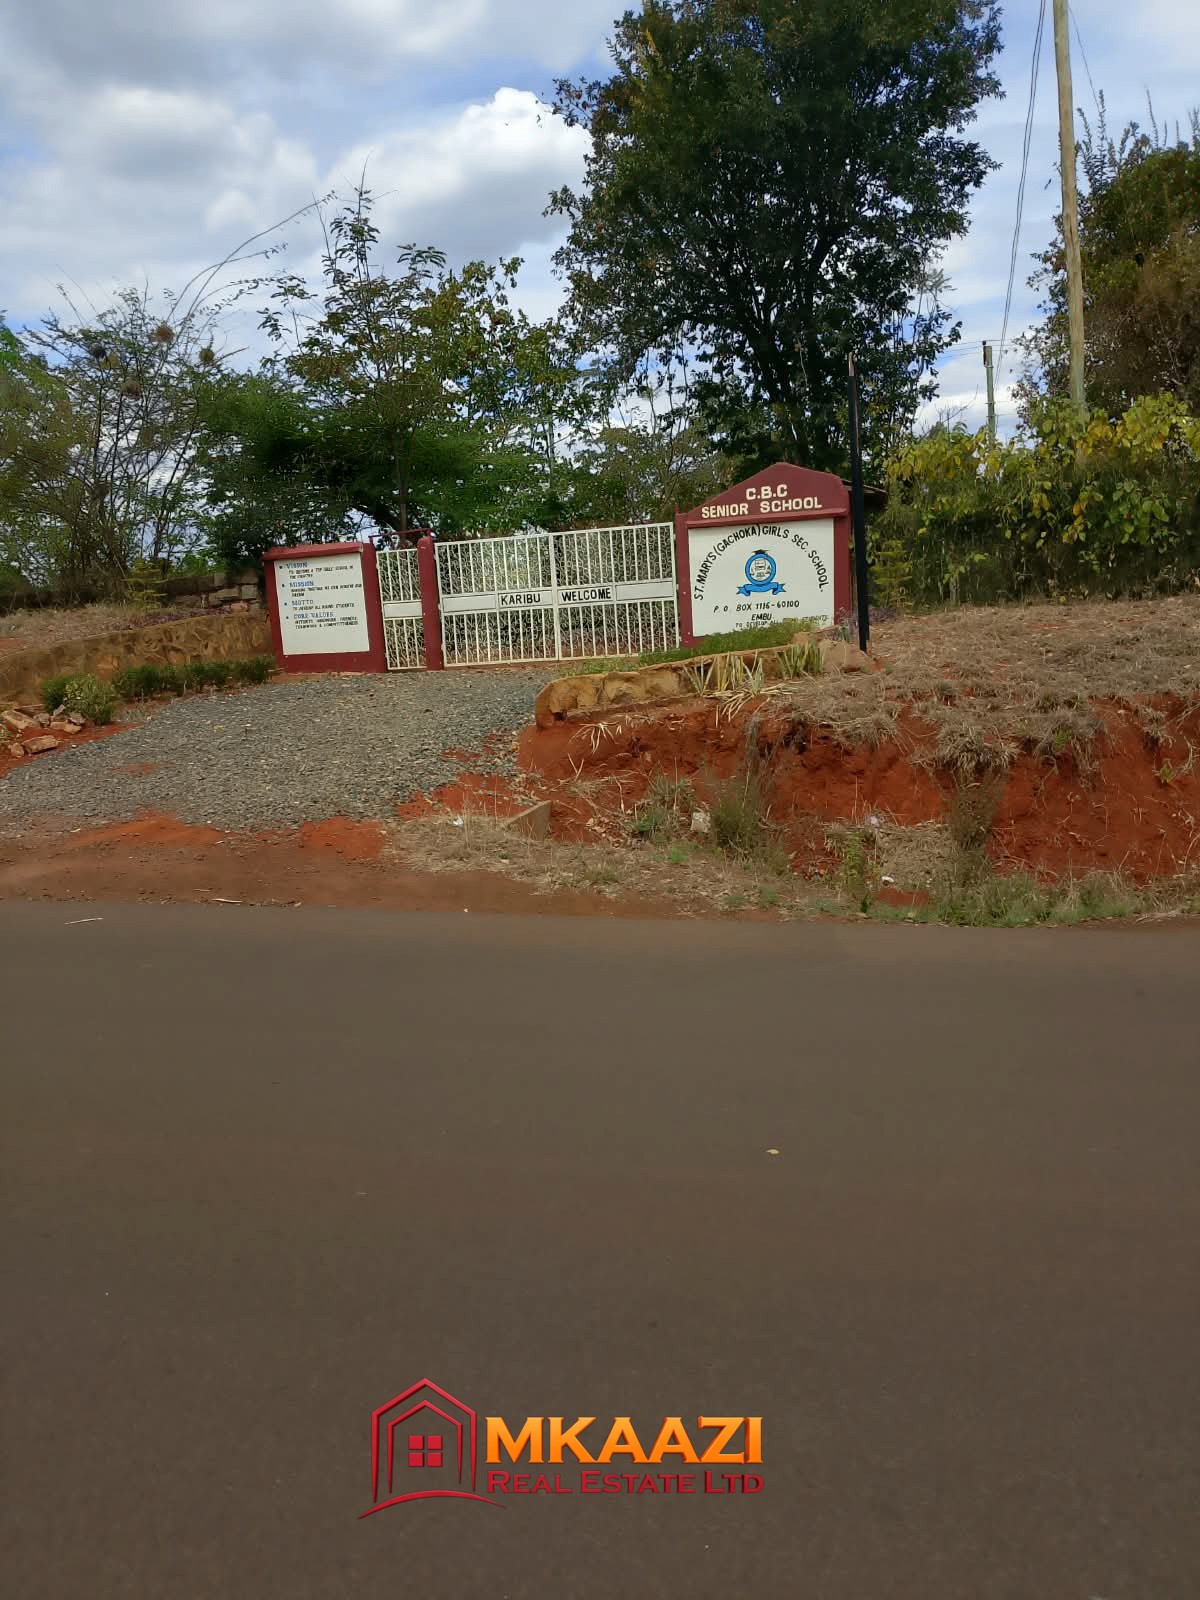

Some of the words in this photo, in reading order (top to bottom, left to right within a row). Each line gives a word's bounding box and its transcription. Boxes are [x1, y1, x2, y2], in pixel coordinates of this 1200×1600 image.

[745, 484, 788, 501] C.B.C
[701, 503, 749, 519] SENIOR
[760, 497, 822, 514] SCHOOL
[762, 525, 790, 539] GIRLS
[501, 593, 541, 606] KARIBU
[561, 588, 611, 602] WELCOME
[735, 603, 752, 612] BOX
